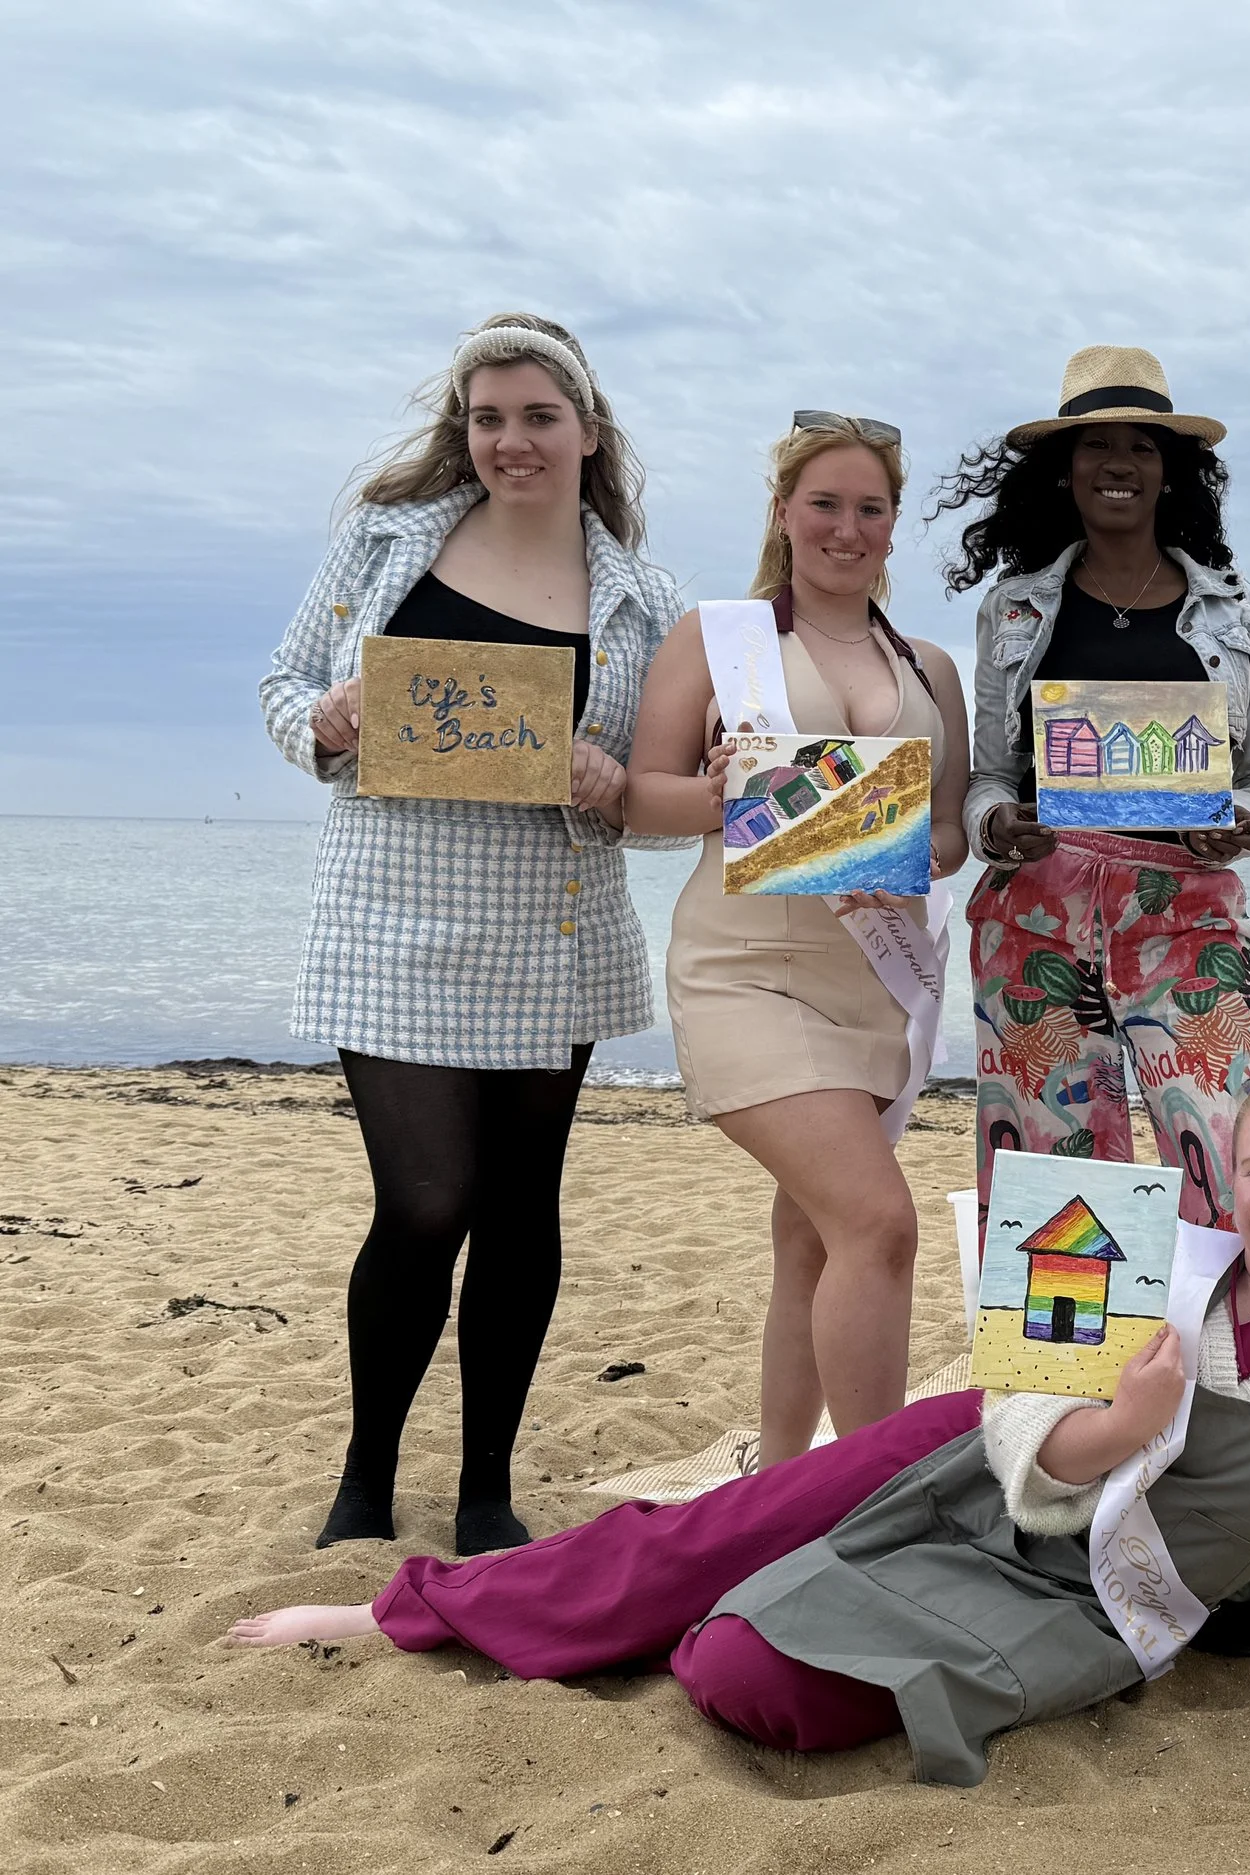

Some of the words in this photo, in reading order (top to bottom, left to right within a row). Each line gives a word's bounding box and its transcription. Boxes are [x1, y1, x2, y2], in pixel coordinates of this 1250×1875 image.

[398, 724, 424, 743] a
[431, 714, 546, 753] Beach
[1097, 1527, 1158, 1661] NTIONAL
